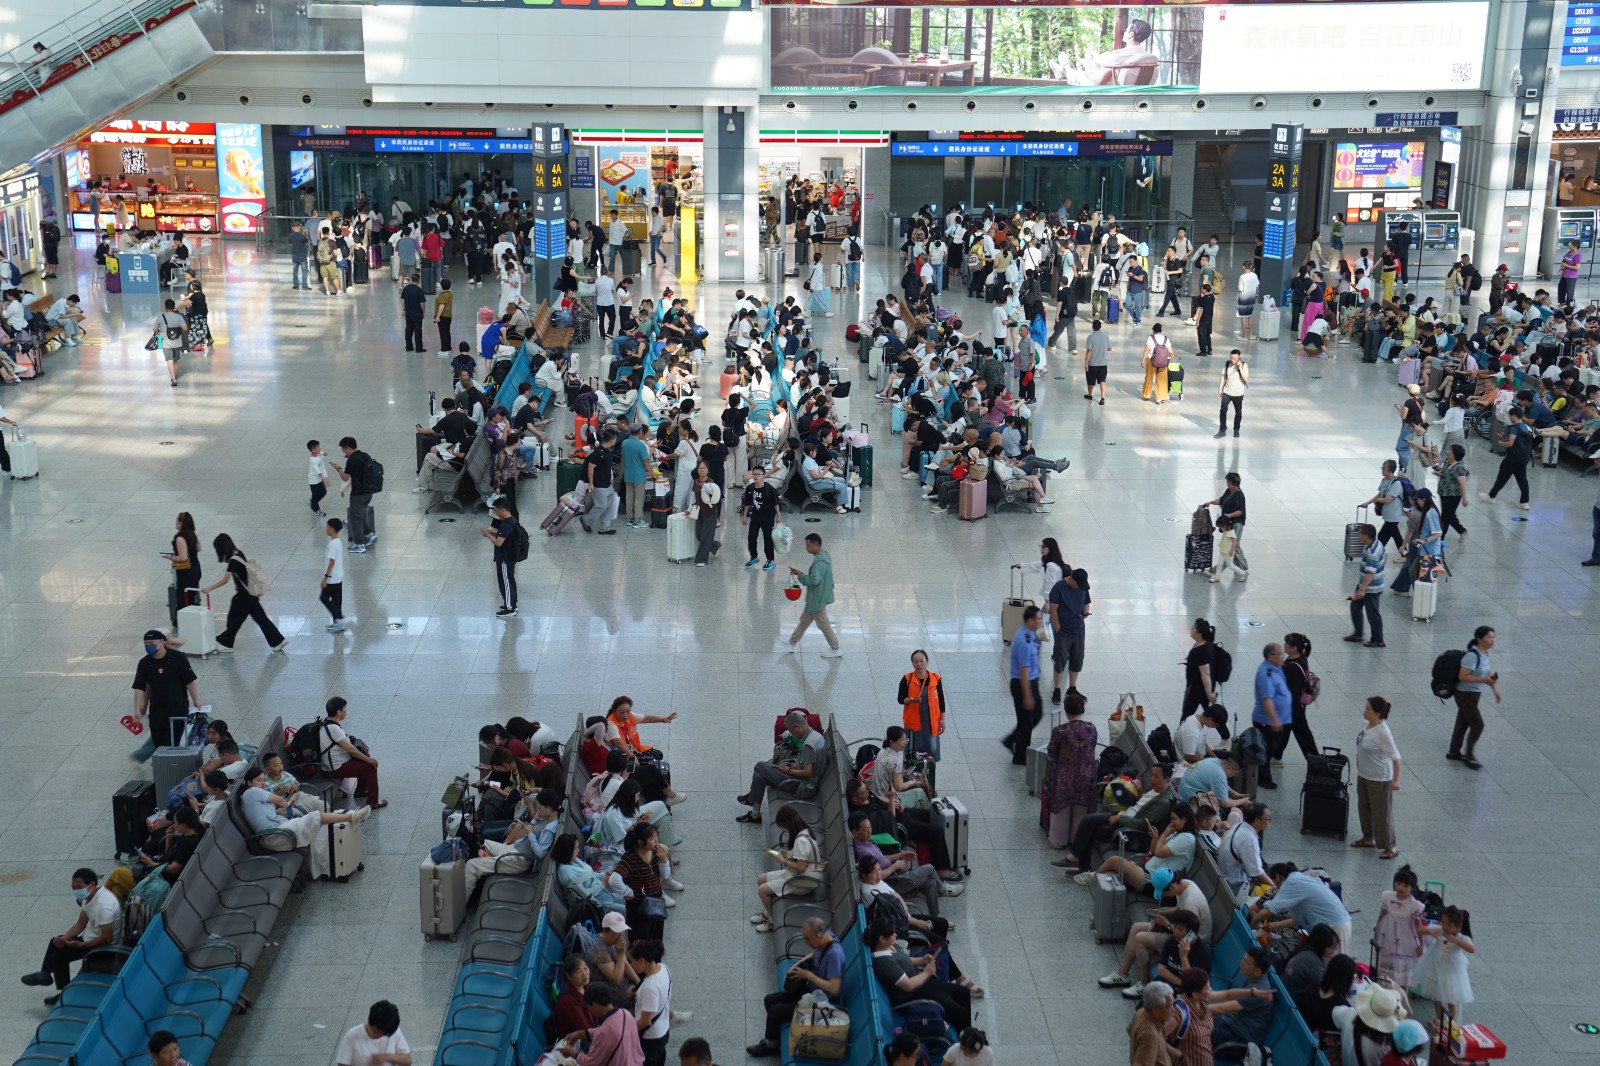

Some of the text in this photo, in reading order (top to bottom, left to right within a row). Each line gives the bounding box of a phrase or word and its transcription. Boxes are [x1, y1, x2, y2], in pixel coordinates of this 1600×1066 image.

[1243, 23, 1461, 50] 森林氧吧 自在南山
[948, 145, 991, 153] 居民身份证通道
[622, 156, 647, 165] 超满足
[535, 163, 544, 174] 4A
[551, 163, 563, 174] 4A
[1272, 163, 1285, 175] 2A
[535, 175, 544, 187] 5A
[552, 176, 563, 188] 5A
[1271, 176, 1284, 188] 3A
